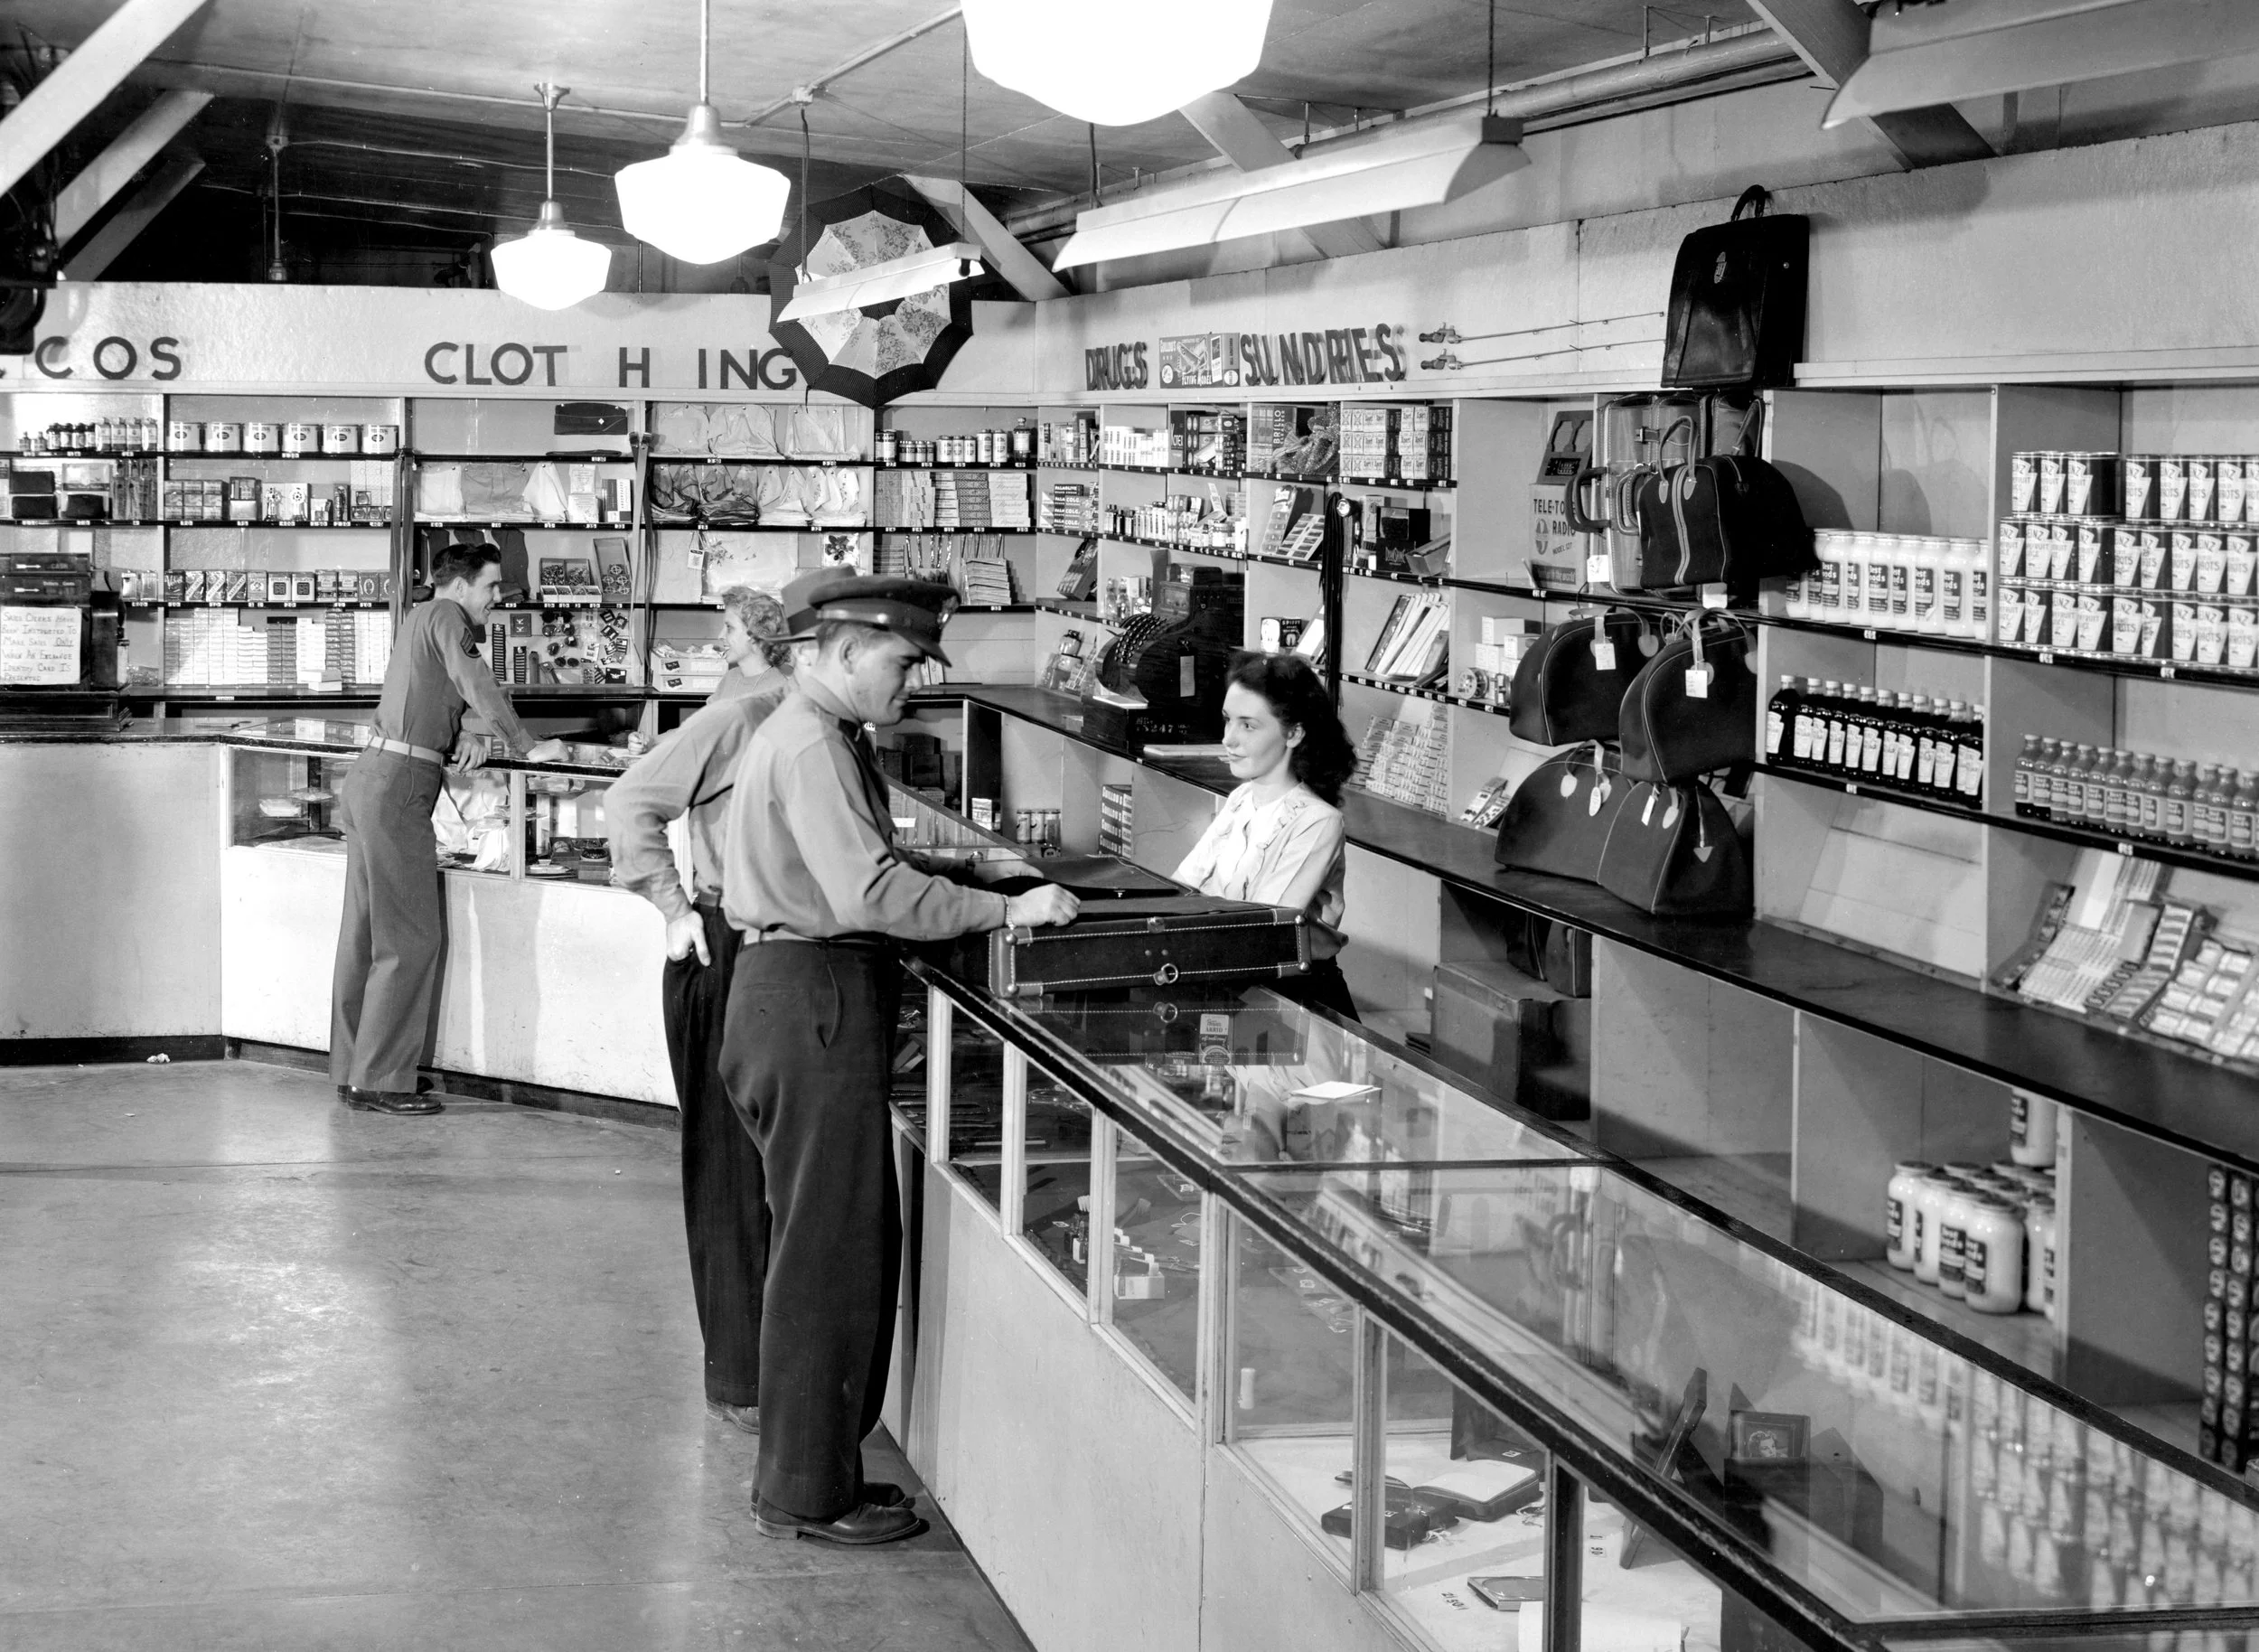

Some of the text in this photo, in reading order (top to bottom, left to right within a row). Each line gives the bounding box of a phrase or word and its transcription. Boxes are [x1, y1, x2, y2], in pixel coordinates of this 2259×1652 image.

[0, 336, 182, 380] COS
[1085, 342, 1148, 391] DRUGS
[1240, 323, 1403, 386] SUNDRIES
[1273, 409, 1282, 445] BRILLO
[1552, 521, 1576, 537] RADIO
